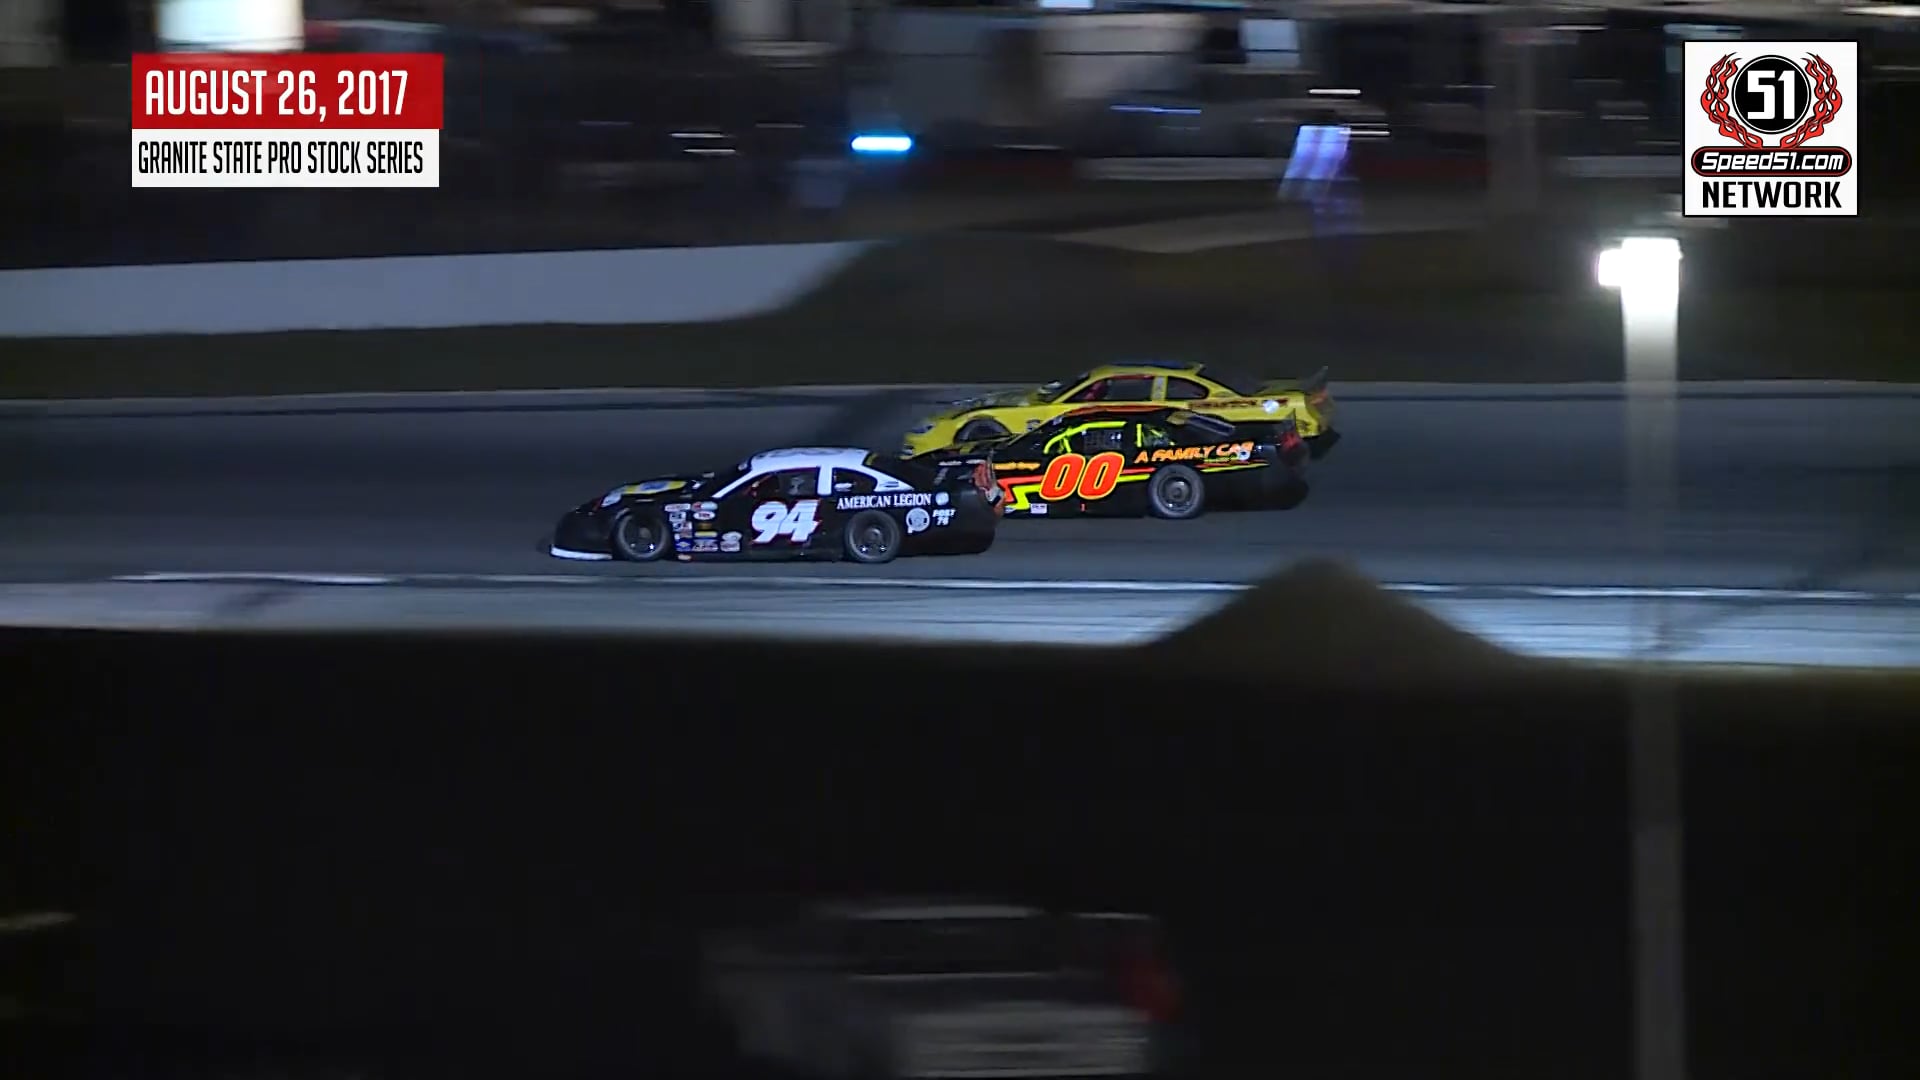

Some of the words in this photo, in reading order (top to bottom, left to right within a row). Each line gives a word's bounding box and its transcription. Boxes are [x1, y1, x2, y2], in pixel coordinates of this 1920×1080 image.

[1133, 451, 1149, 464] A
[1151, 445, 1216, 462] FAMILY
[1039, 451, 1126, 501] 00
[836, 494, 891, 510] AMERICAN
[893, 492, 932, 508] LEGION
[750, 500, 821, 544] 94
